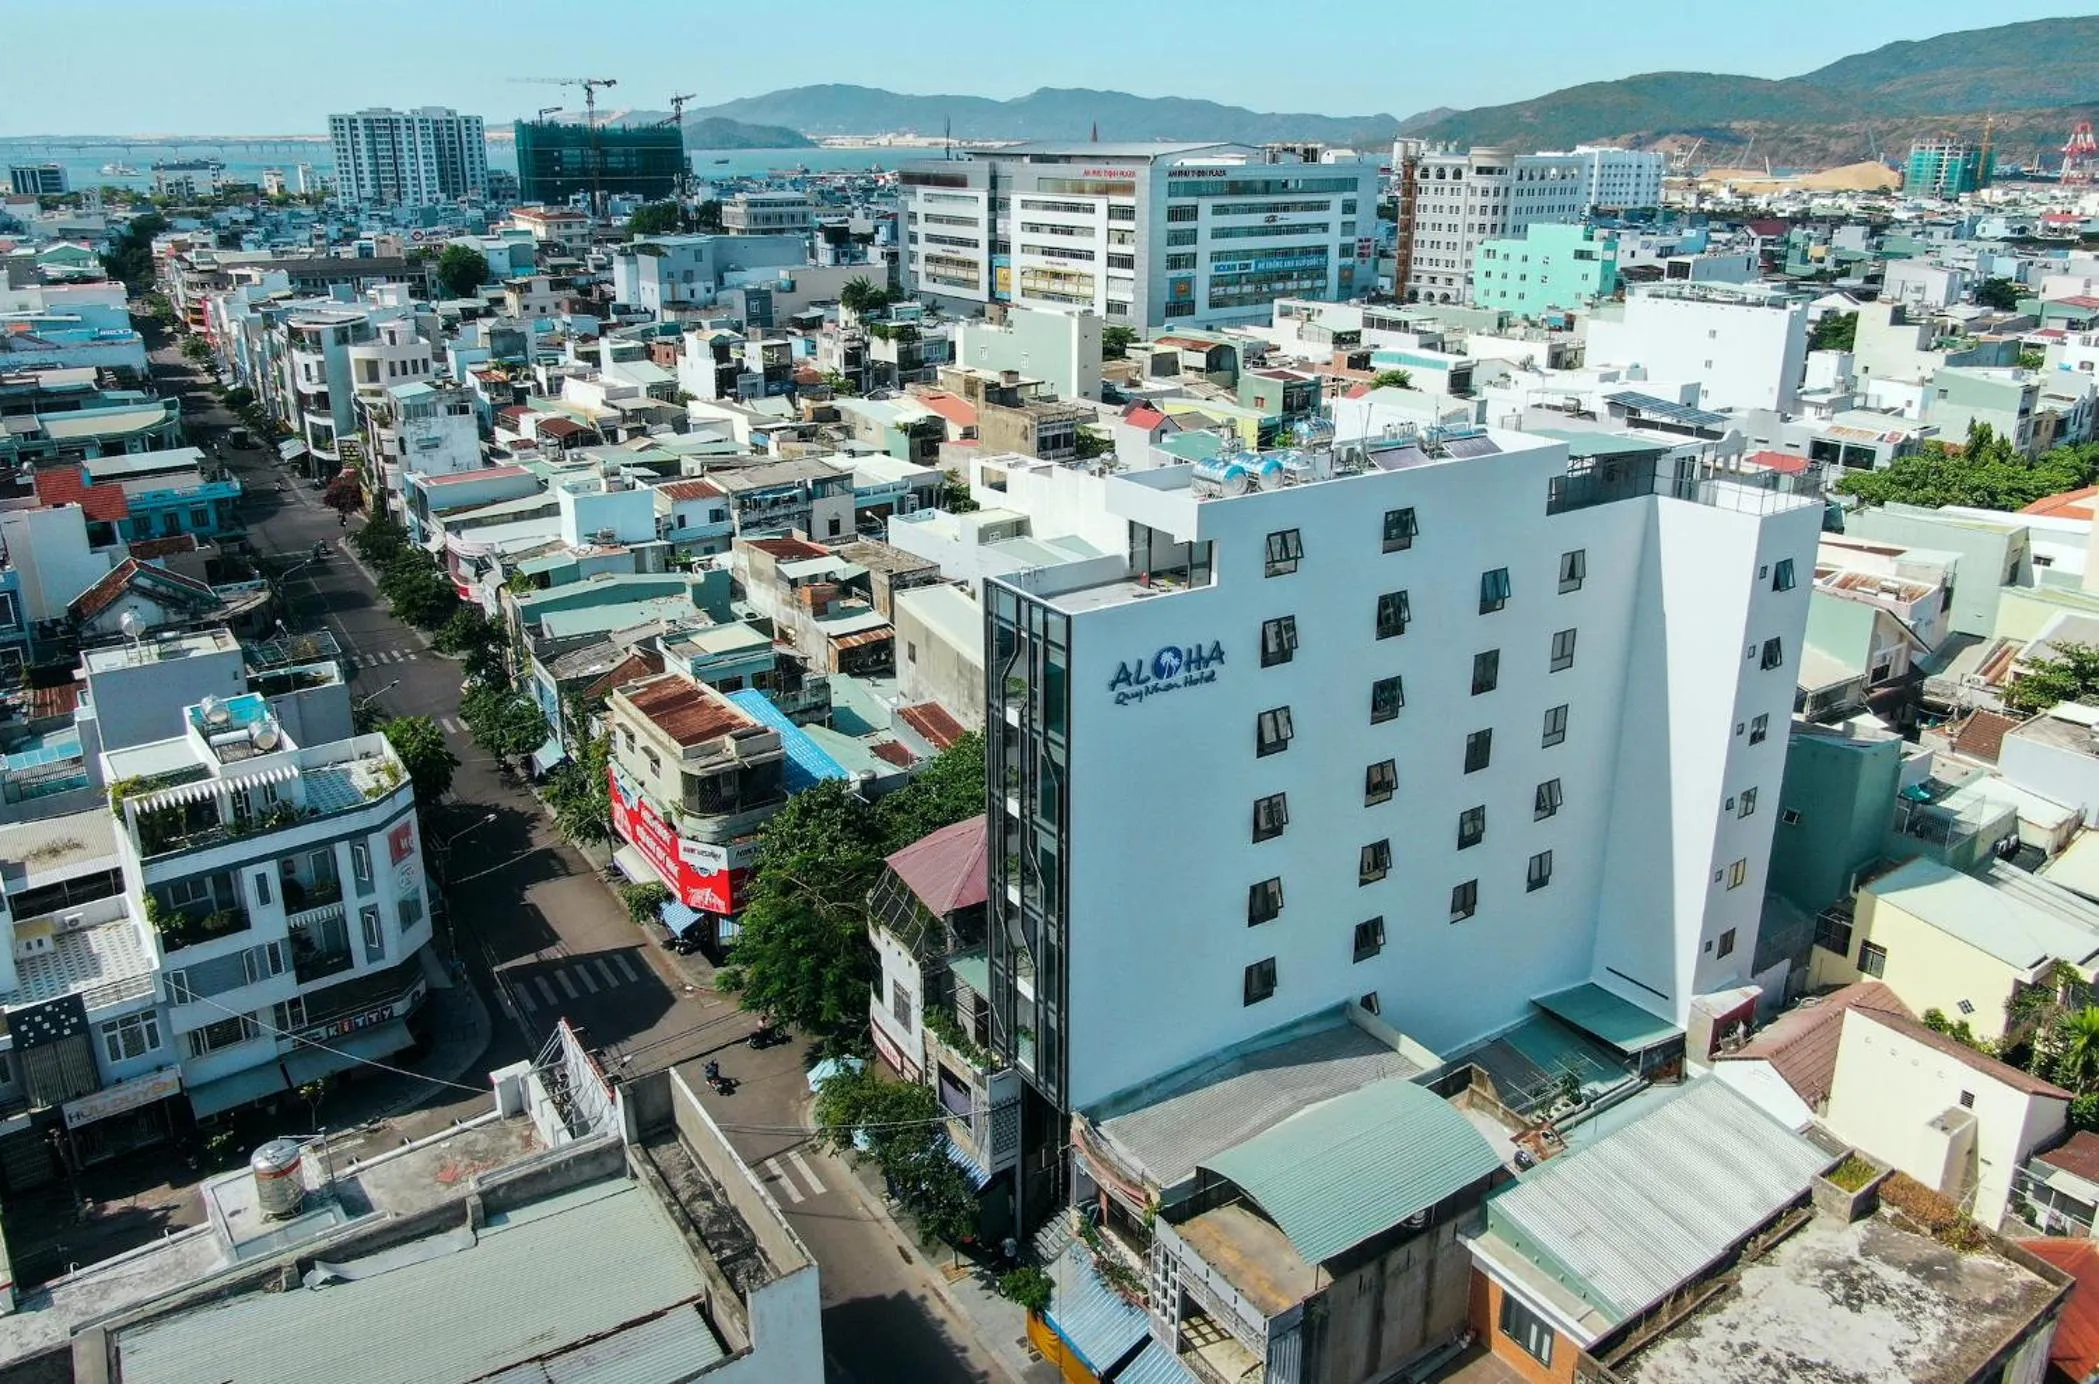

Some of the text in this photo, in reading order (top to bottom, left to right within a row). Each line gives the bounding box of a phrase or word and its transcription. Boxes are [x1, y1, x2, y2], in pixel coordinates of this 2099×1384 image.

[1108, 640, 1226, 691] ALOHA
[1184, 669, 1217, 687] Hotel
[327, 1006, 393, 1037] KITTY
